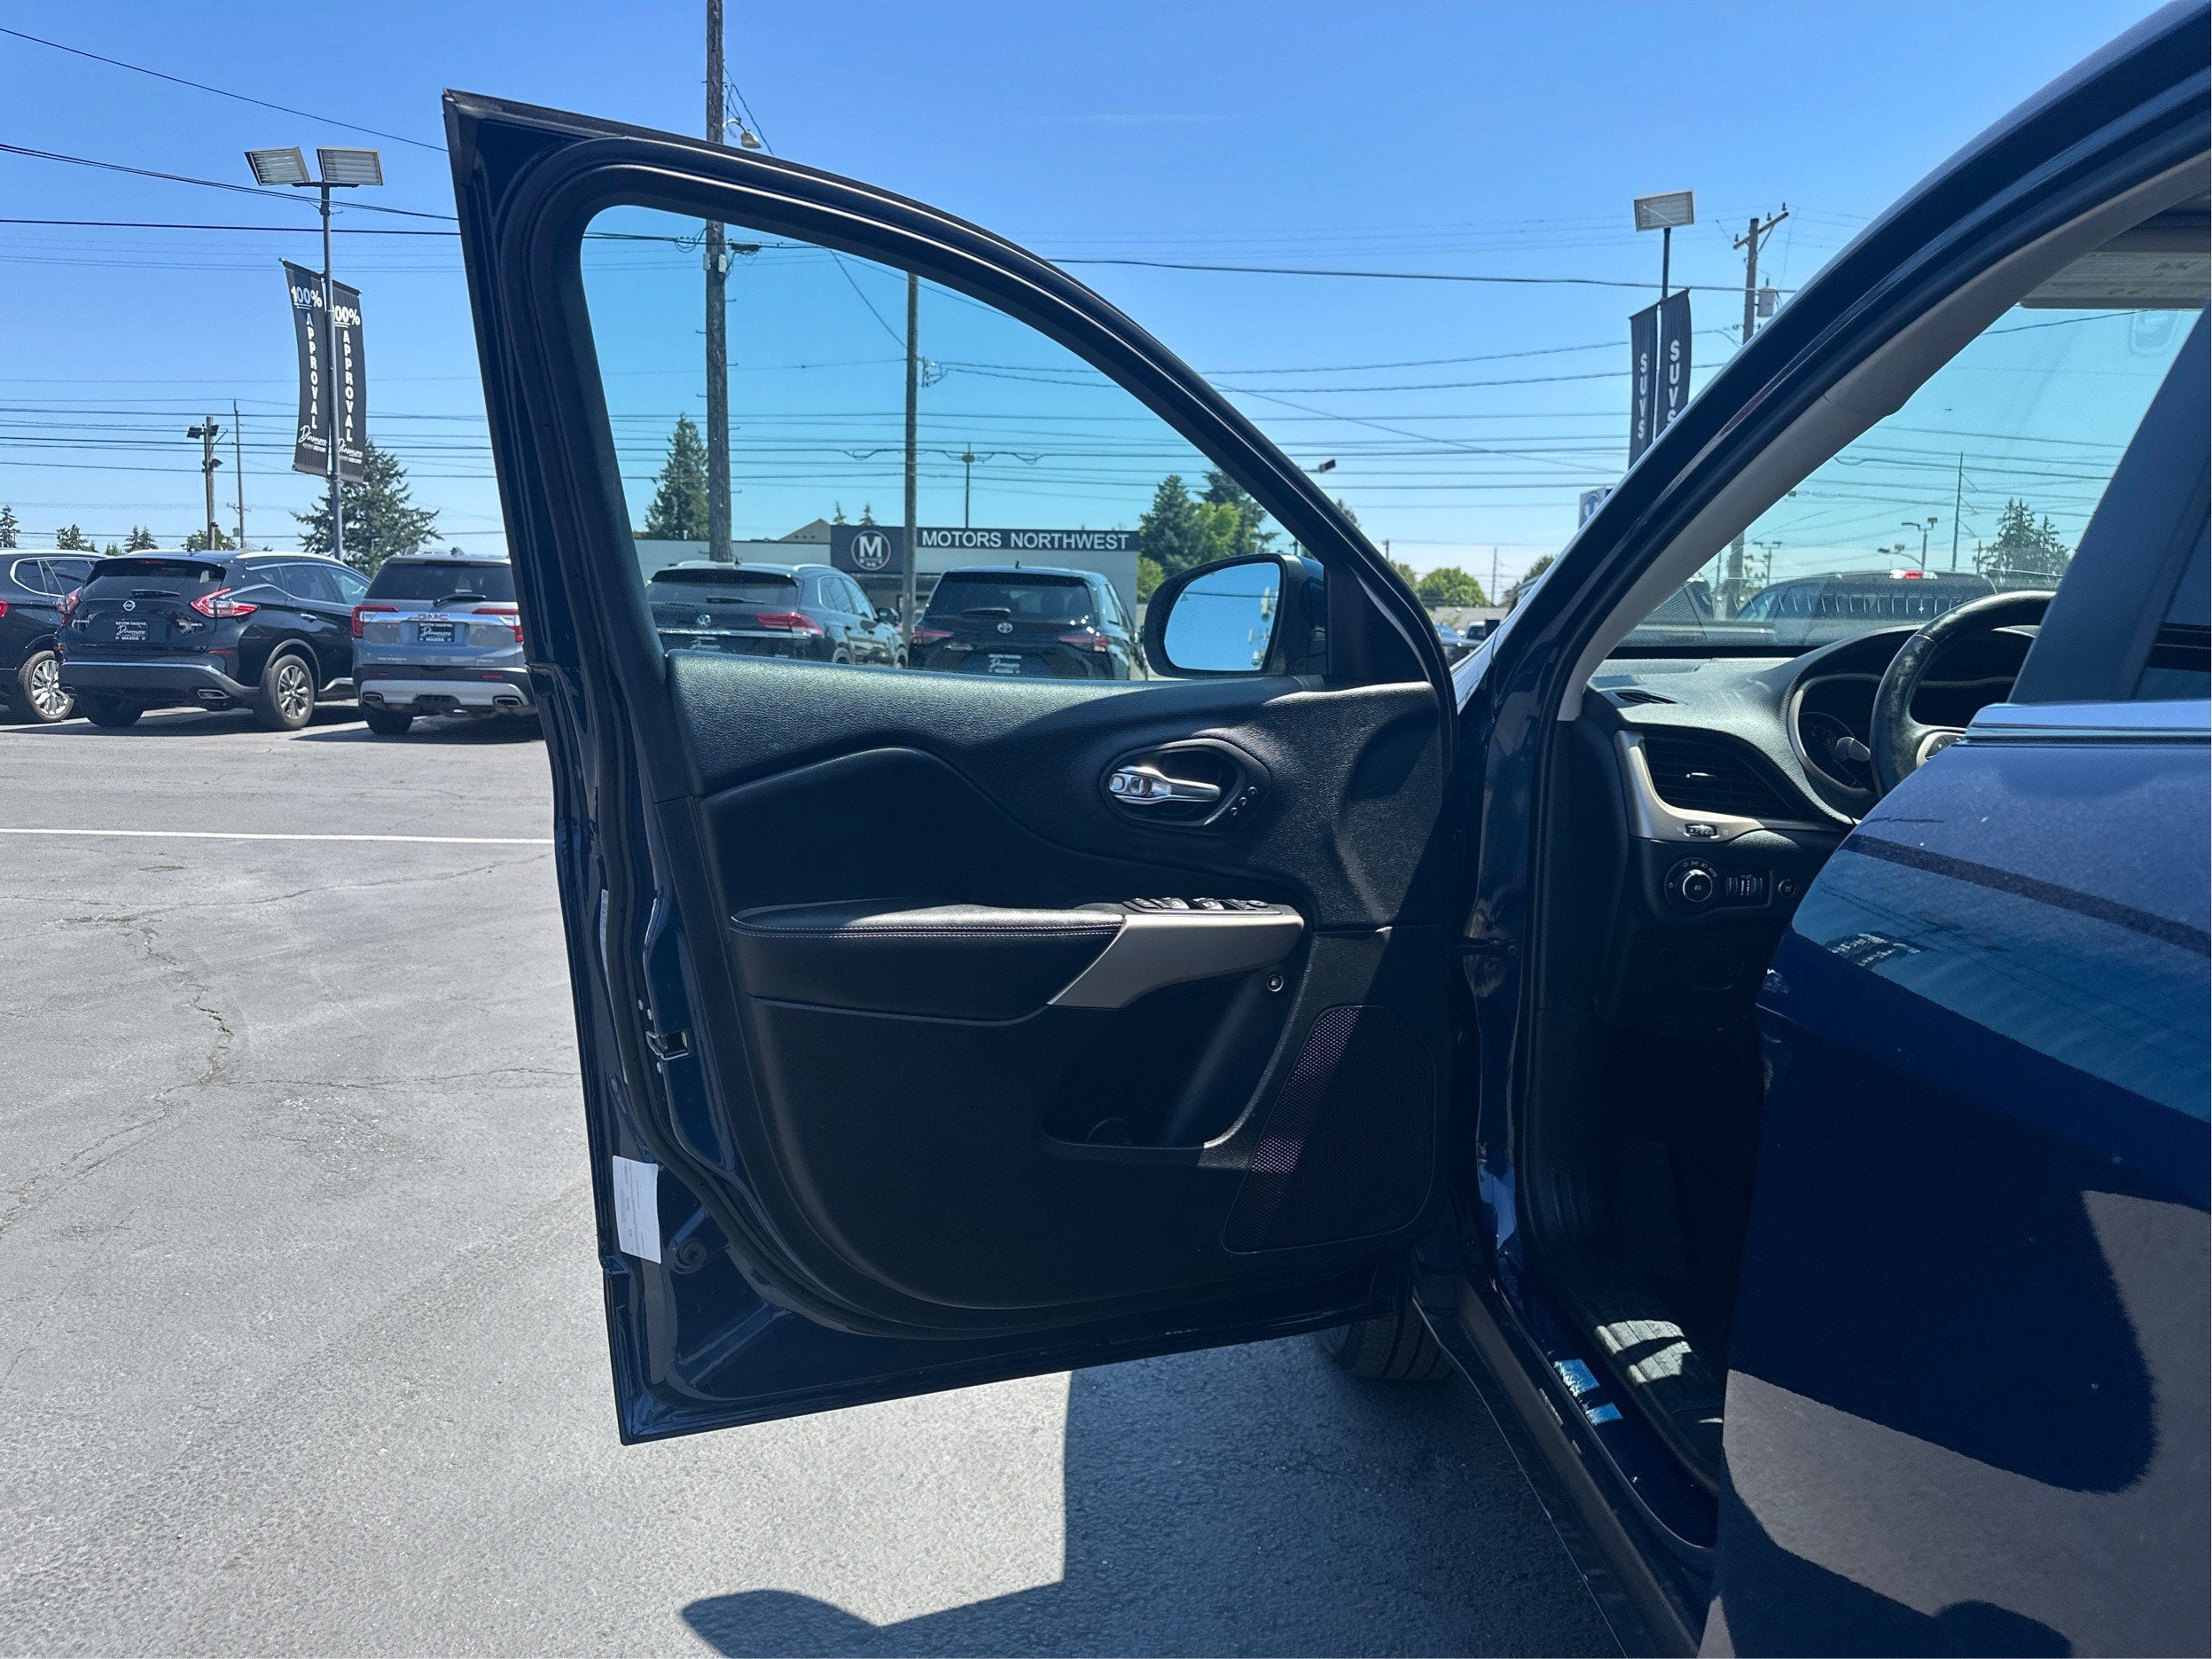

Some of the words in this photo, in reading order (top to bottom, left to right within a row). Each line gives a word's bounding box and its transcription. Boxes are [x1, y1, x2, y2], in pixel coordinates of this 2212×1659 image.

[291, 286, 323, 309] 100%
[306, 313, 317, 430] APPROVAL
[343, 330, 354, 442] APPROVAL
[1638, 353, 1648, 440] SUVS
[859, 536, 883, 557] M
[922, 530, 1002, 548] MOTORS
[1011, 533, 1129, 550] NORTHWEST
